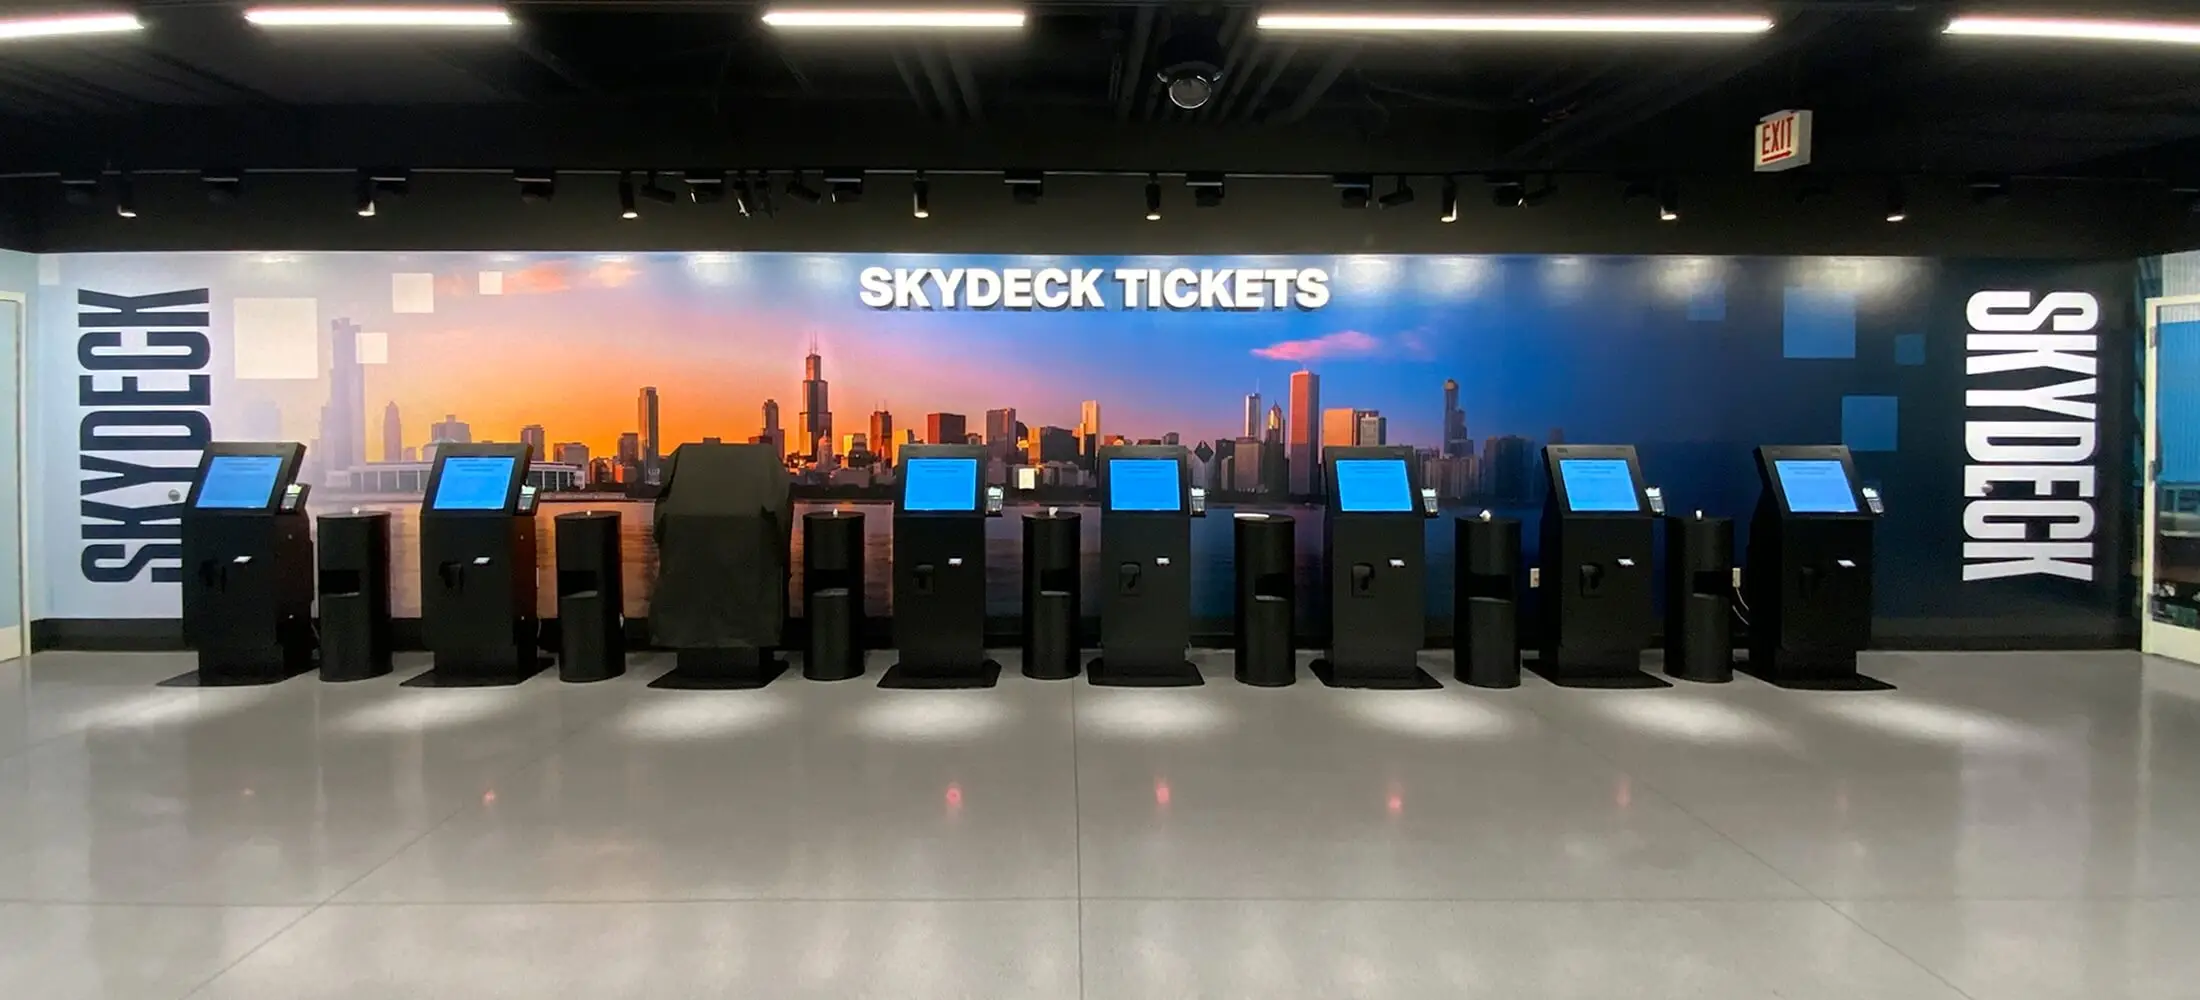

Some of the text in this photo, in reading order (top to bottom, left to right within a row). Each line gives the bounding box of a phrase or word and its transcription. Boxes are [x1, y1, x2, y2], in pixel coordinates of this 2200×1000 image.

[1762, 116, 1794, 155] EXIT
[860, 267, 1330, 310] SKYDECK TICKETS
[78, 287, 212, 584] SKYDECK
[1963, 290, 2099, 582] SKYDECK
